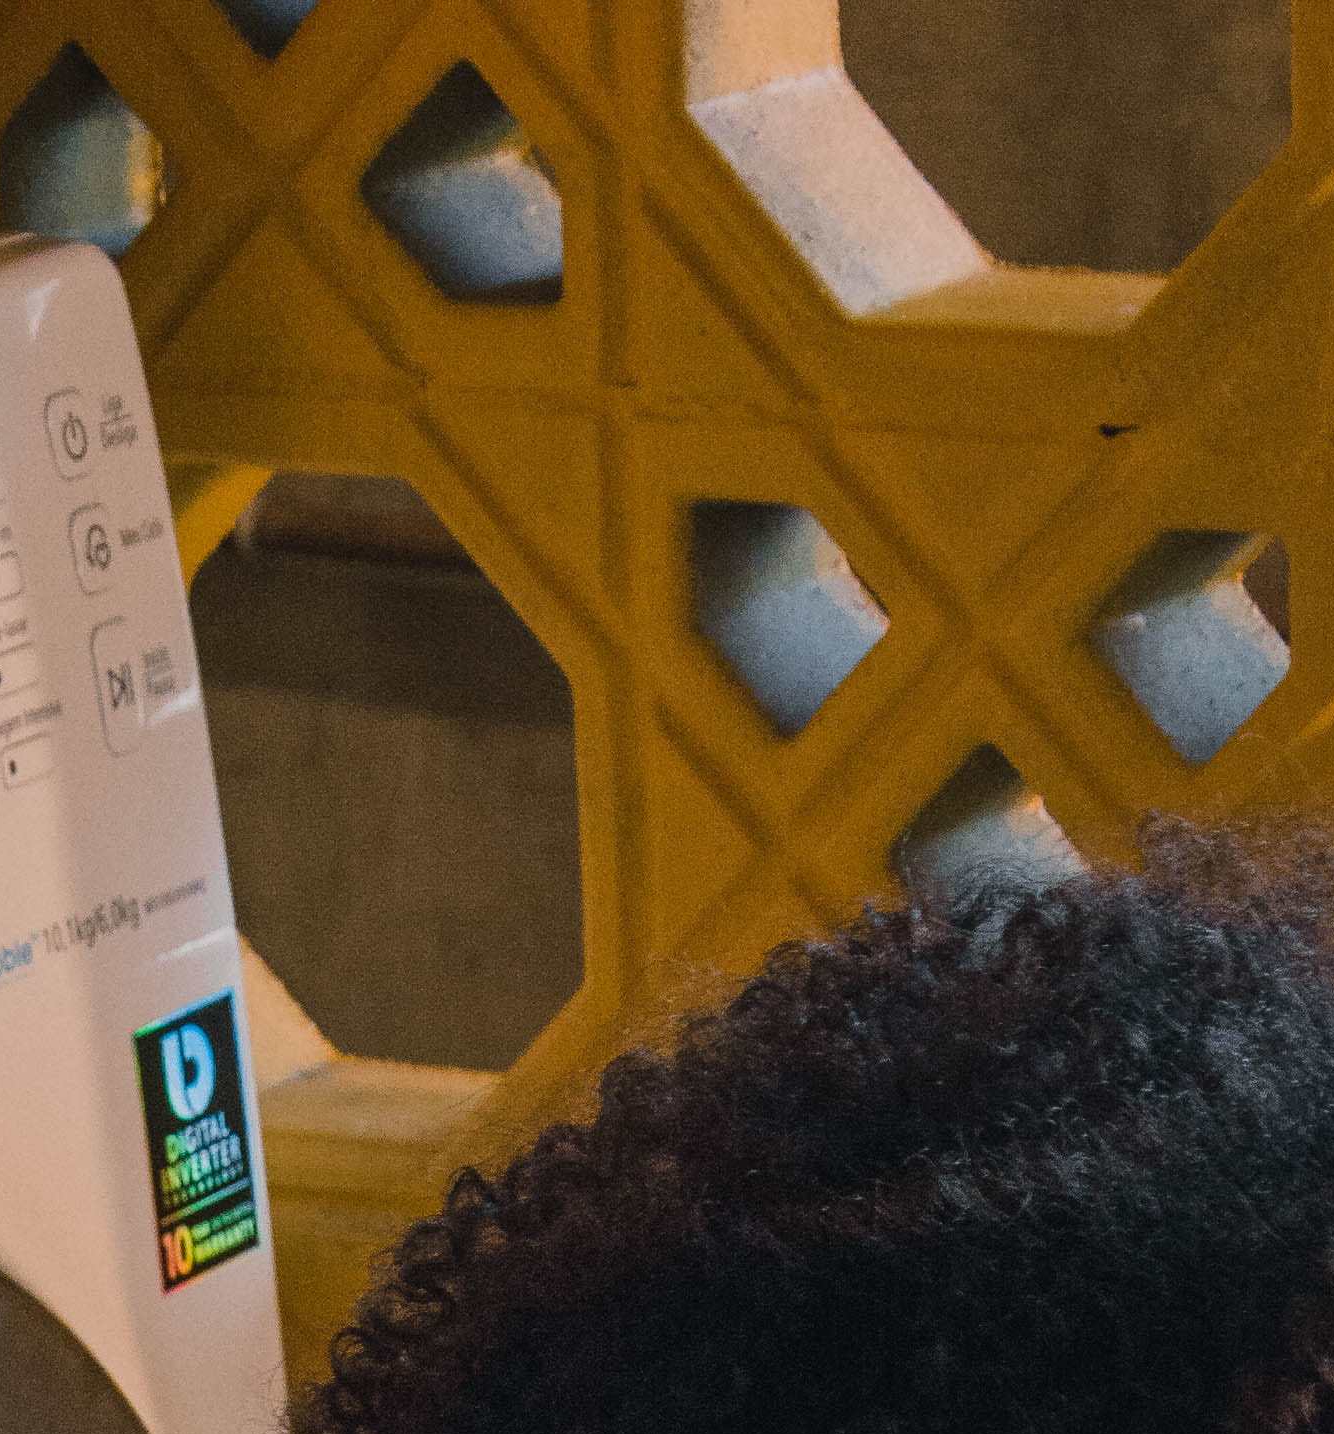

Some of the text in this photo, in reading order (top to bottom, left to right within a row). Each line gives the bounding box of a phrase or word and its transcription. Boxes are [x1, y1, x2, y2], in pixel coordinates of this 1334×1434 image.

[160, 1132, 242, 1192] INVERTER
[164, 1110, 230, 1164] DIGITAL
[161, 1223, 194, 1280] 10
